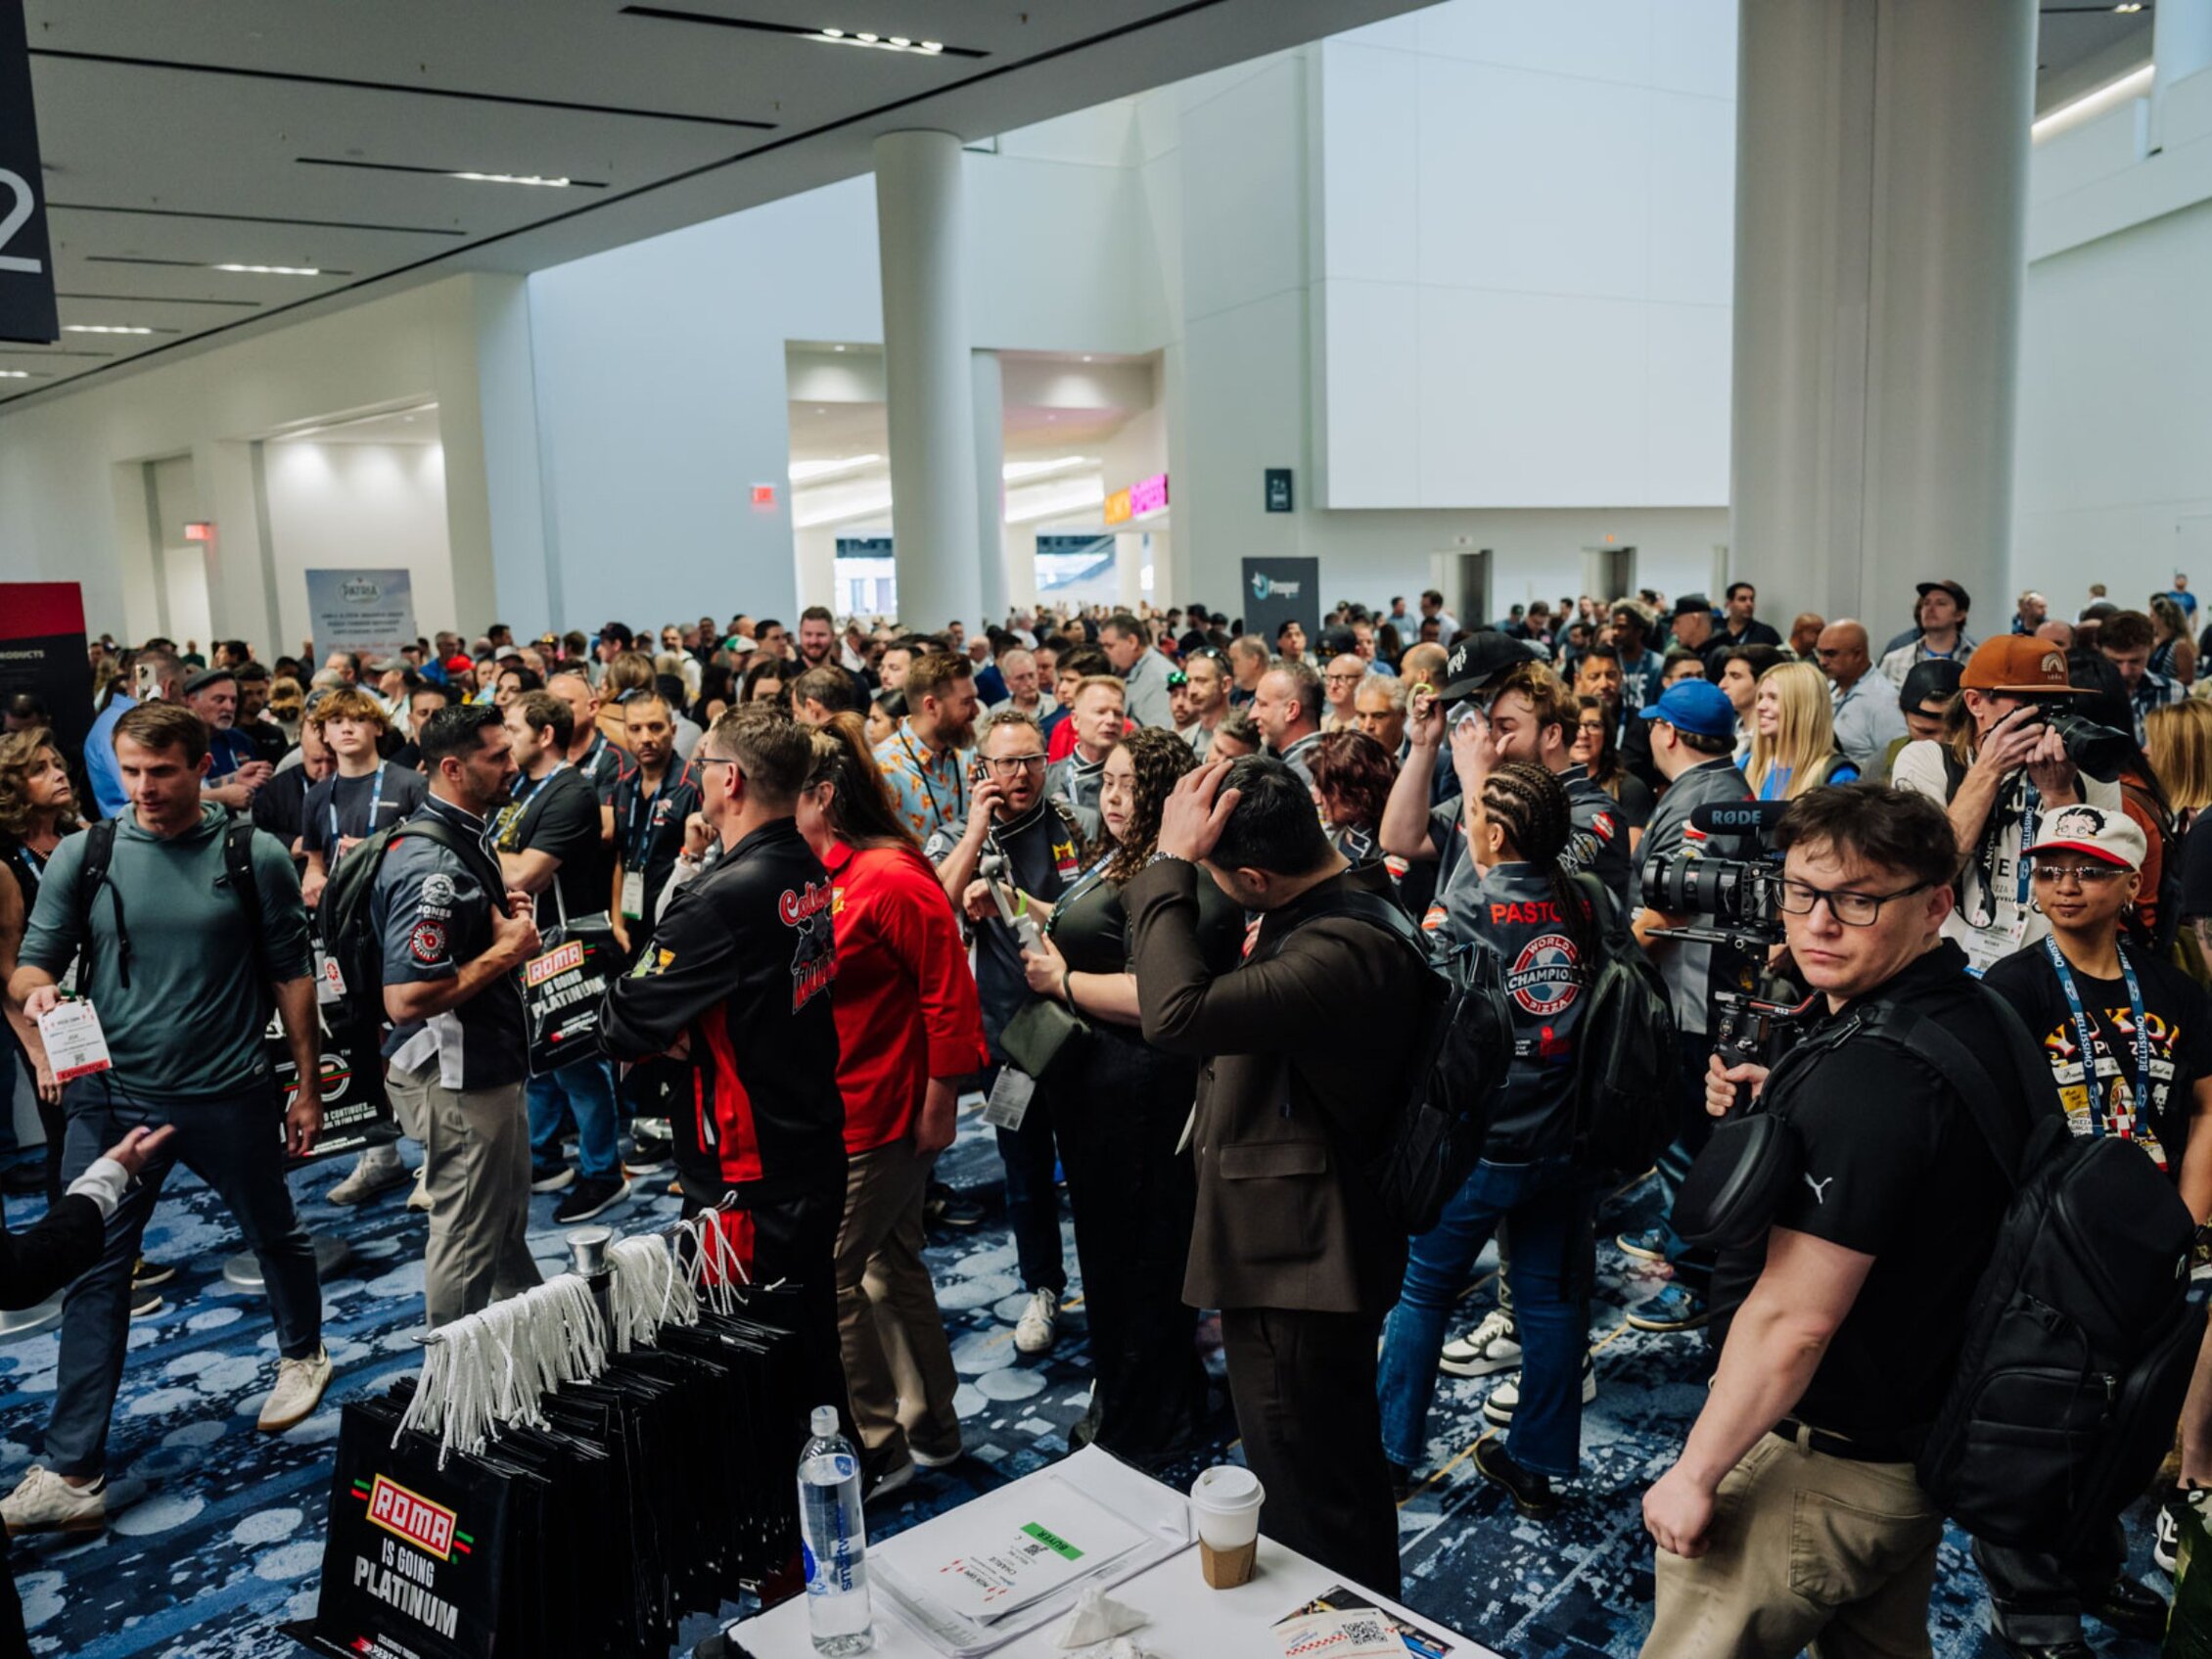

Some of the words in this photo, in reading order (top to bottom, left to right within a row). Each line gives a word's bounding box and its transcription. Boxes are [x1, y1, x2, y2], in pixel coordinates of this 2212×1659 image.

[1712, 809, 1762, 825] RØDE
[416, 904, 452, 918] JONES
[530, 945, 580, 982] ROMA
[1528, 938, 1570, 954] WORLD
[530, 975, 607, 1019] PLATINUM
[1508, 968, 1574, 989] CHAMPIO
[1529, 998, 1569, 1013] PIZZA
[2074, 1011, 2095, 1069] BELLISSIMO
[2135, 1015, 2149, 1072] BELLISSIMO
[375, 1485, 450, 1548] ROMA
[1037, 1529, 1070, 1552] BUYER
[382, 1537, 394, 1567] IS
[396, 1545, 436, 1589] GOING
[353, 1554, 459, 1640] PLATINUM
